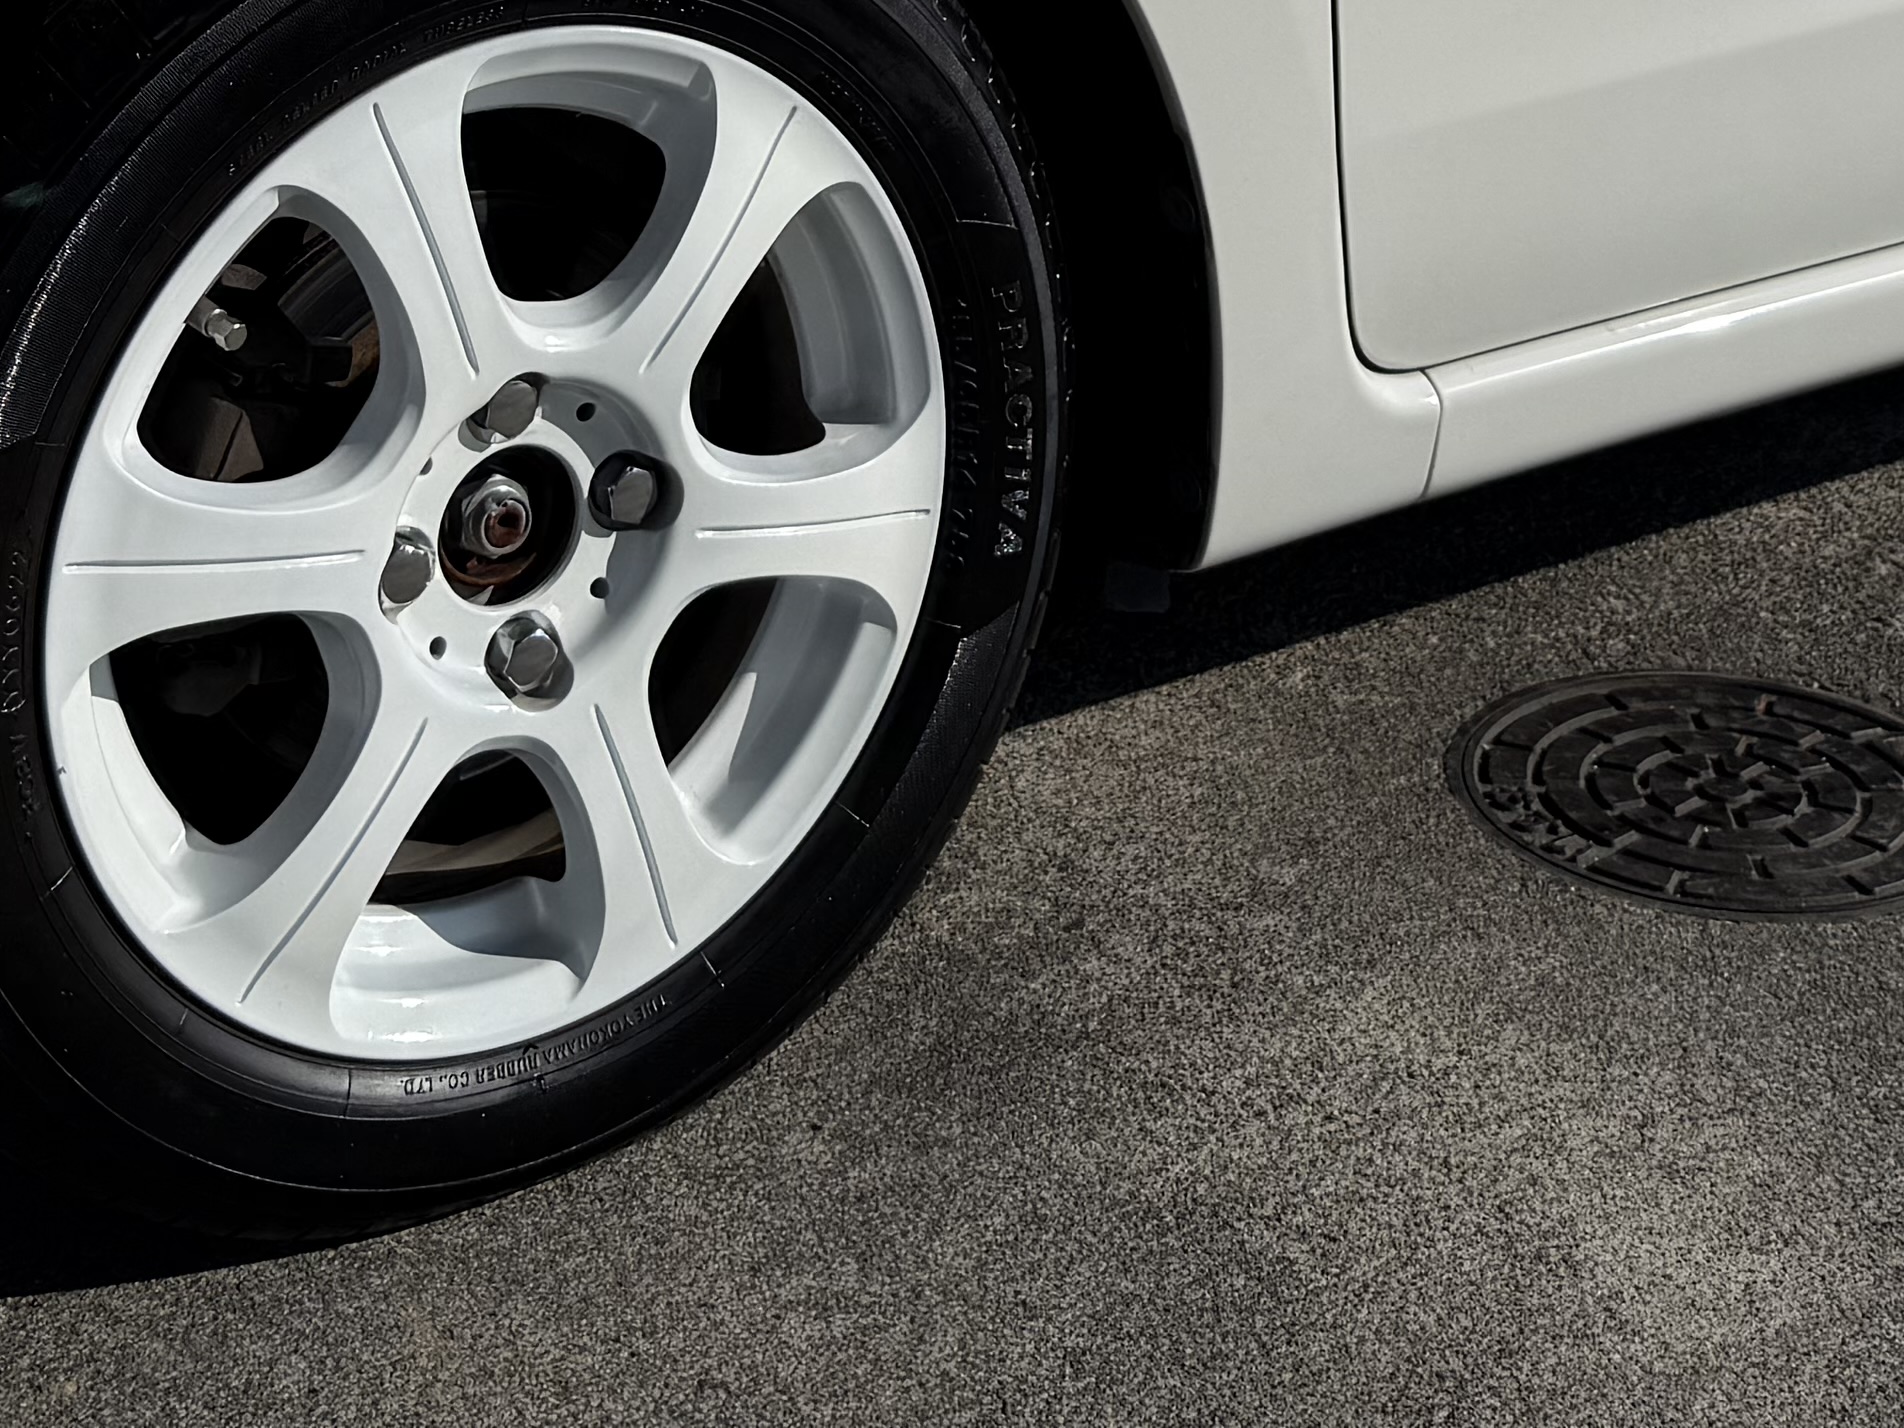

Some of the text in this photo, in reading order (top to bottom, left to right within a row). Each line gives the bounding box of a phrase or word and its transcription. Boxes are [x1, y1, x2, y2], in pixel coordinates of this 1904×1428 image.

[991, 279, 1034, 557] PRACTIVA
[545, 1017, 634, 1065] YOKOHAMA
[400, 1076, 434, 1096] LTD.
[476, 1055, 540, 1084] RUBBER
